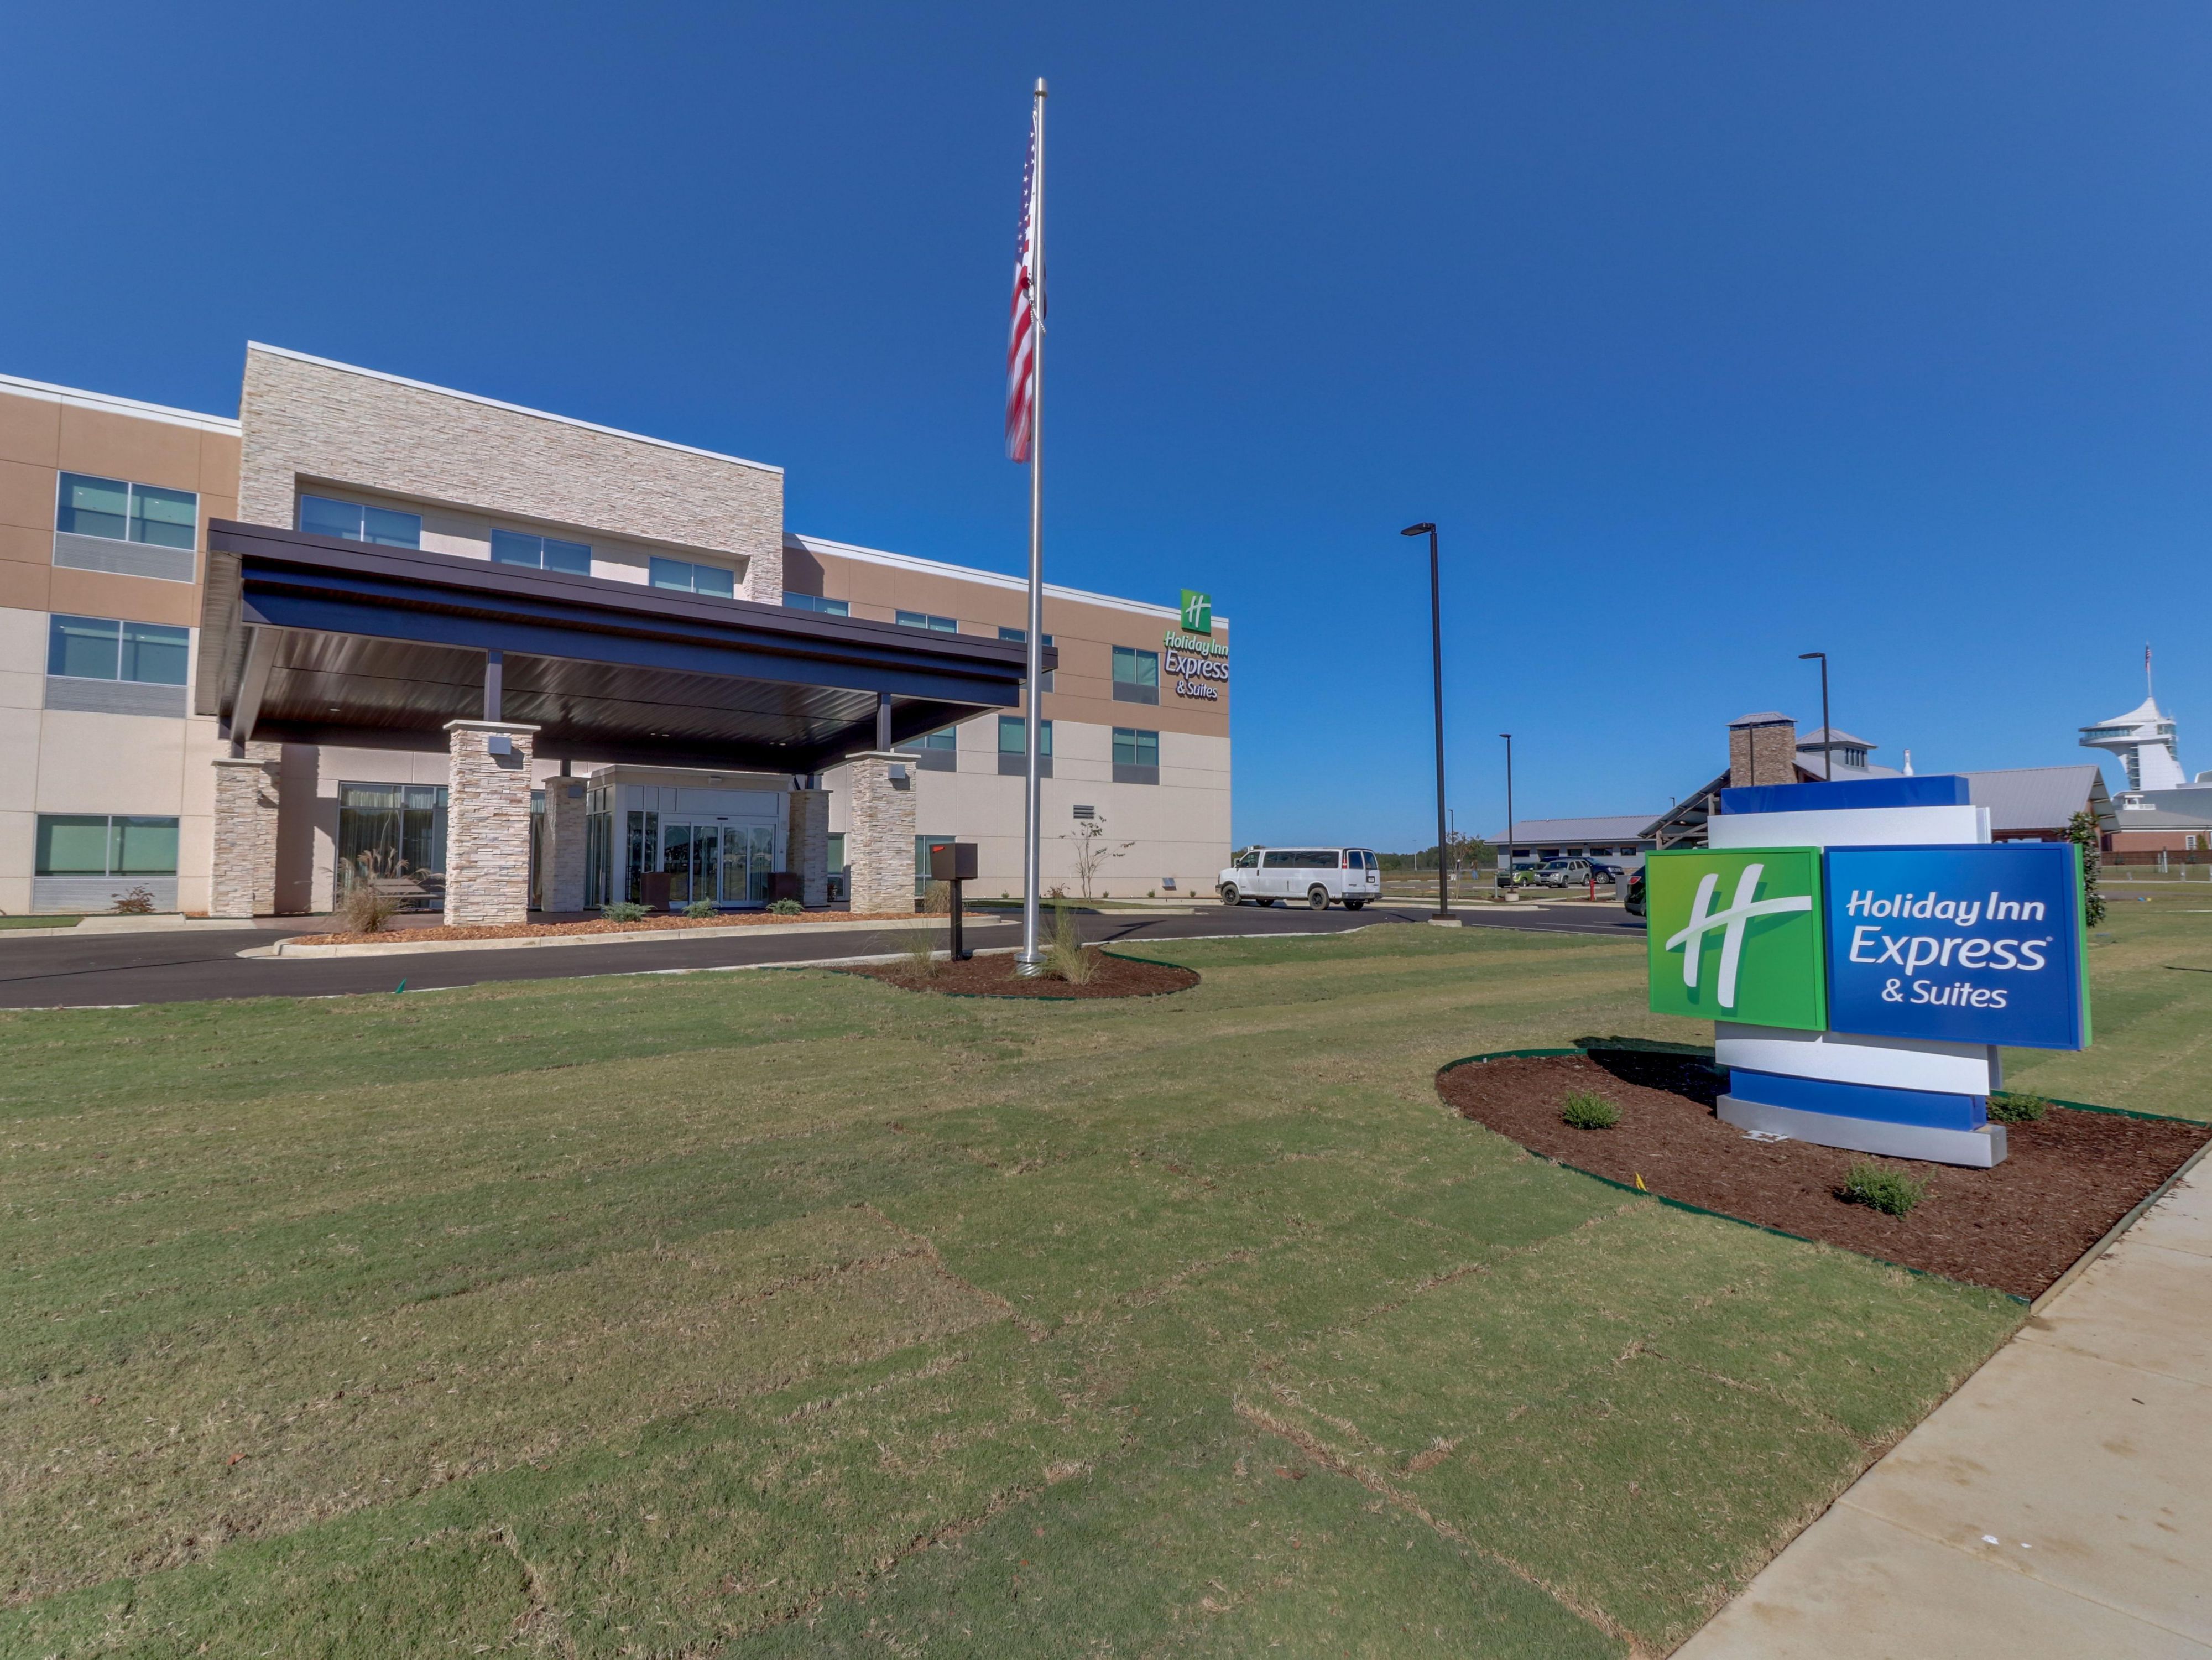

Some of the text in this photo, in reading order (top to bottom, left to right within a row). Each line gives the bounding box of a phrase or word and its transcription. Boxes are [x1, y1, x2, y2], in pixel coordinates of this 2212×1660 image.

[1185, 595, 1211, 628] H
[1164, 631, 1228, 656] Holiday Inn
[1165, 649, 1229, 679] Express
[1177, 680, 1217, 698] & Suites
[1846, 889, 2044, 926] Holiday Inn
[1666, 863, 1812, 1008] H
[1849, 925, 2048, 976] Express
[1881, 978, 2008, 1008] & Suites
